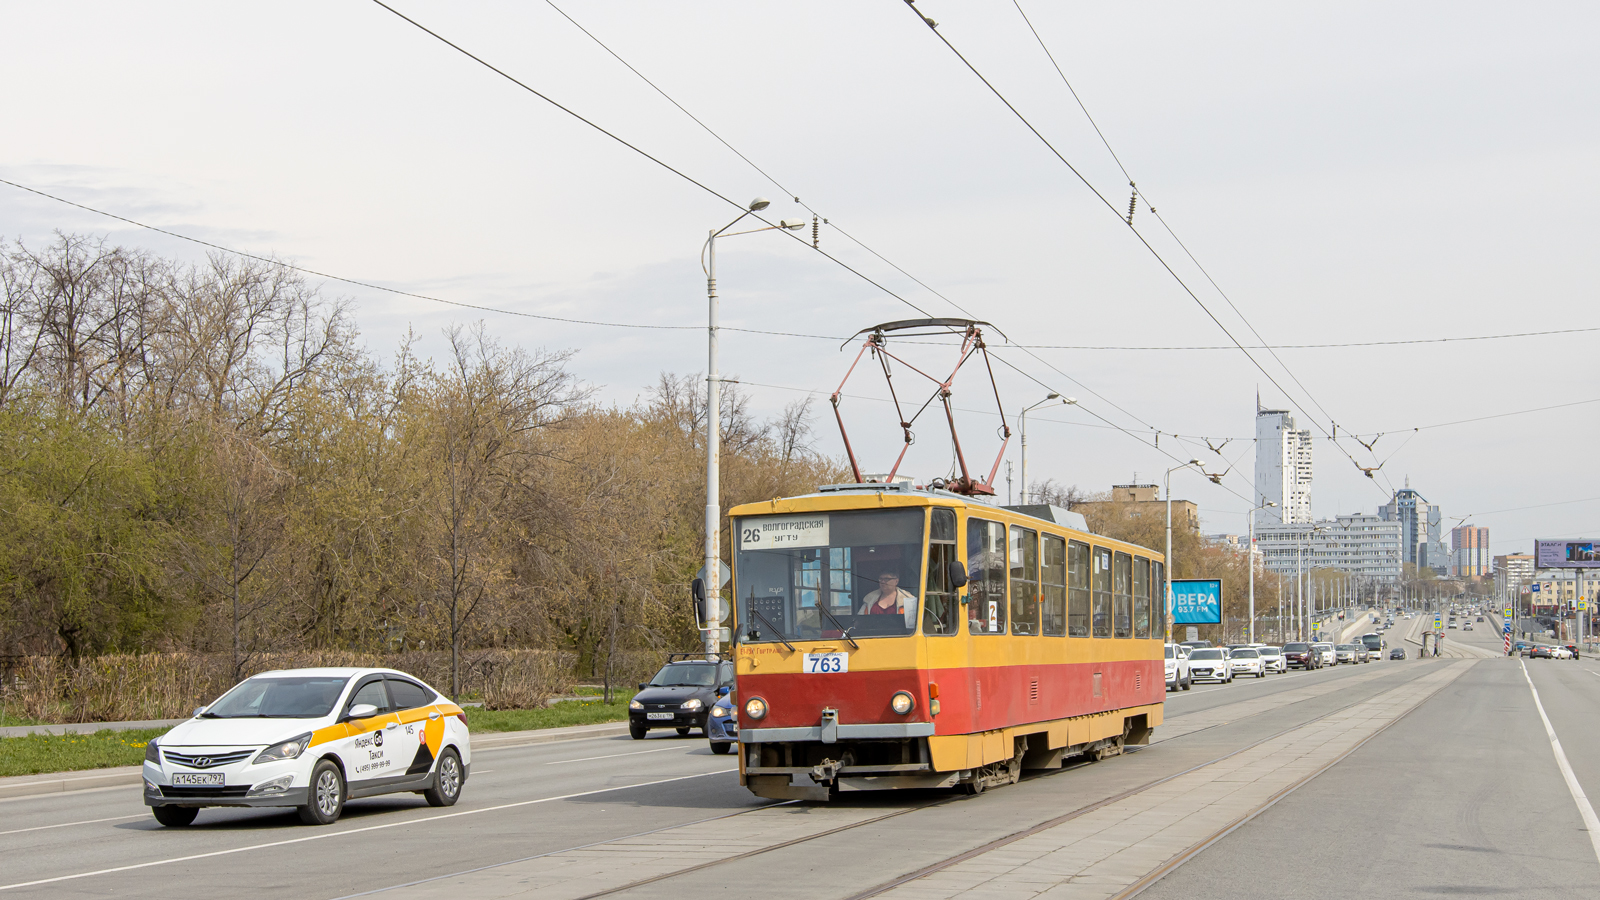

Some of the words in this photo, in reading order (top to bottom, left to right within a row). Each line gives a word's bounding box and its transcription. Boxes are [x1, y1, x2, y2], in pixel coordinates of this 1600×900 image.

[743, 528, 760, 543] 26
[774, 534, 799, 542] УГТУ
[1178, 593, 1217, 605] ВЕРА
[989, 605, 996, 621] 2
[810, 657, 841, 673] 763
[405, 725, 414, 735] 145
[355, 737, 374, 749] Яндекс
[369, 750, 384, 760] Такси
[360, 764, 370, 773] (495)
[176, 774, 207, 784] А145ЕК
